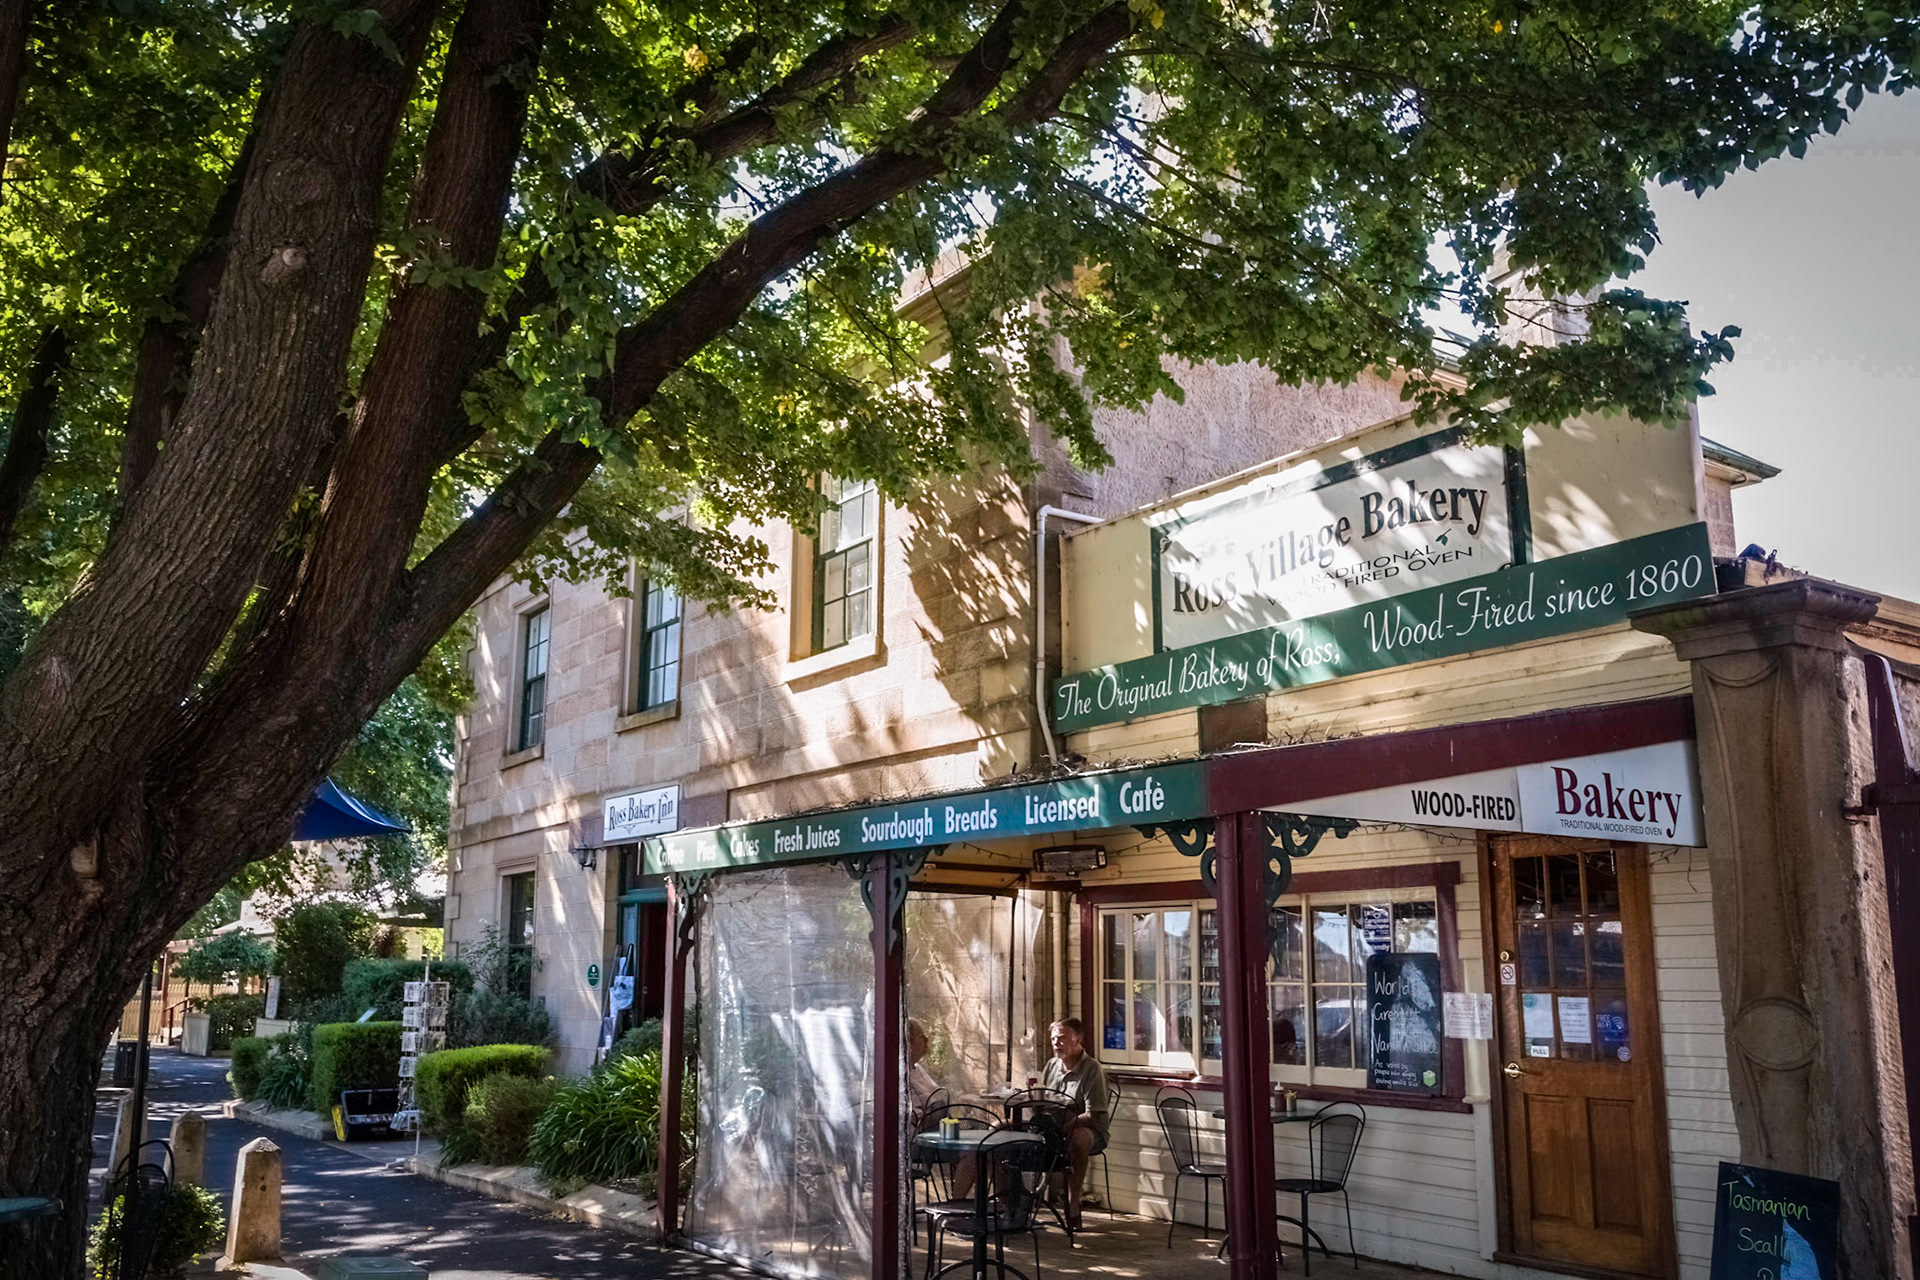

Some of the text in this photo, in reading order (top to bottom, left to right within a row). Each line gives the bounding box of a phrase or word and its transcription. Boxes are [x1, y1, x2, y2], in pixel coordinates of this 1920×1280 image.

[1173, 480, 1488, 614] Ross Village Bakery
[1344, 566, 1400, 589] FIRED
[1407, 546, 1473, 572] OVEN
[1057, 554, 1703, 721] The Original Bakery of Ross, Wood-Fired since 1860
[608, 797, 674, 831] Ross Bakery Inn
[656, 842, 685, 867] Coffee
[696, 839, 717, 862] Pies
[730, 832, 760, 858] Cakes
[774, 825, 804, 854] Fresh
[805, 827, 841, 850] Juices
[862, 807, 933, 845] Sourdough
[945, 799, 998, 834] Breads
[1025, 784, 1099, 825] Licensed
[1411, 766, 1683, 839] WOOD-FIRED Bakery
[1560, 819, 1663, 836] TRADITIONAL WOOD-FIRED OVEN
[1721, 1180, 1812, 1221] Tasmanian
